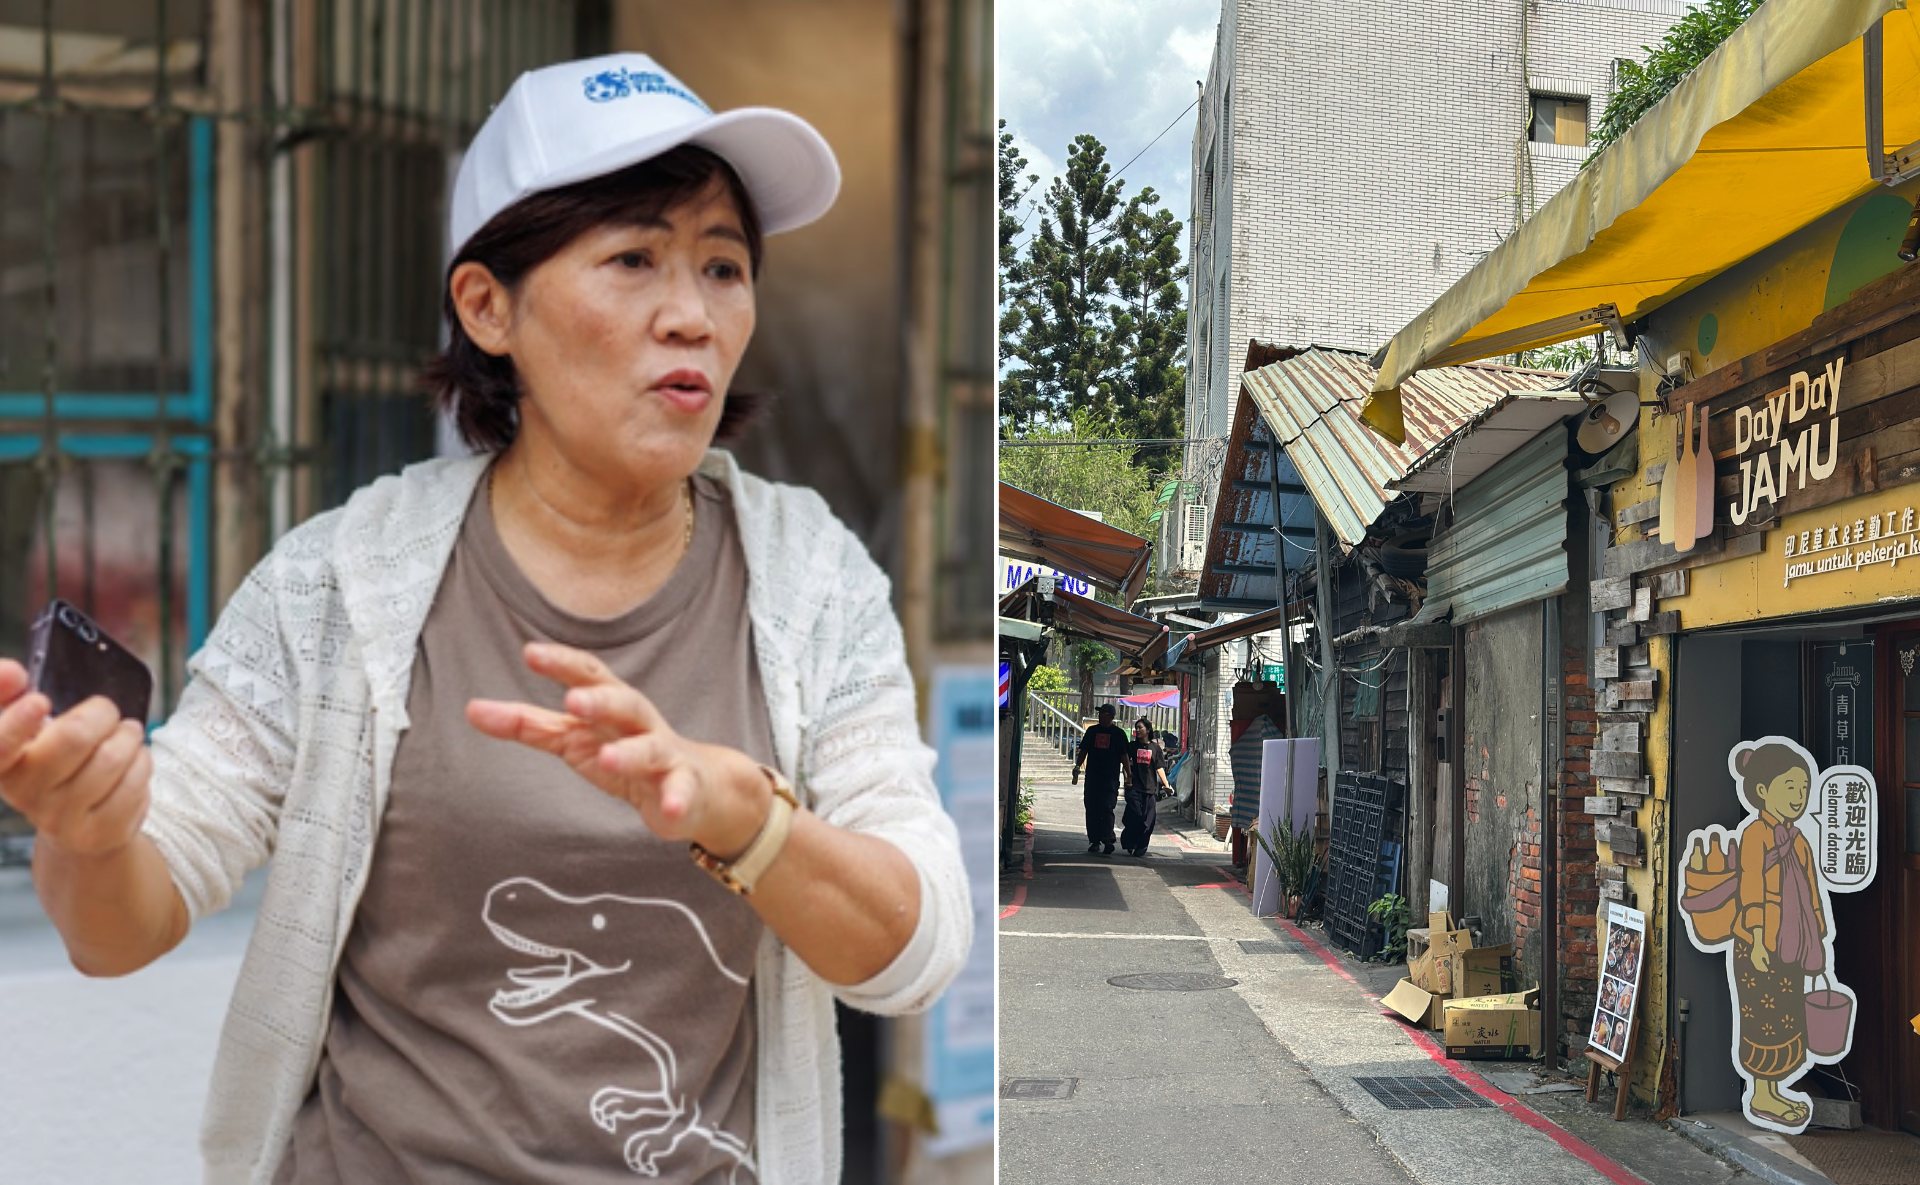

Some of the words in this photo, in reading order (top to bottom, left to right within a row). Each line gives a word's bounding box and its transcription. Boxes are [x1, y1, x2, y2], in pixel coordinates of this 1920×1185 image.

[1730, 417, 1839, 526] JAMU
[1785, 506, 1920, 557] 印尼草本&辛勤工作
[1816, 547, 1853, 573] untuk
[1855, 539, 1906, 572] pekerja
[1909, 533, 1920, 557] k
[1006, 564, 1089, 596] MANG
[1831, 661, 1855, 677] Jamu
[1836, 694, 1849, 766] 青草店
[1827, 782, 1843, 830] selamat
[1844, 781, 1867, 875] 歡迎光臨
[1823, 832, 1843, 874] datang
[1463, 1026, 1500, 1040] 竹炭水
